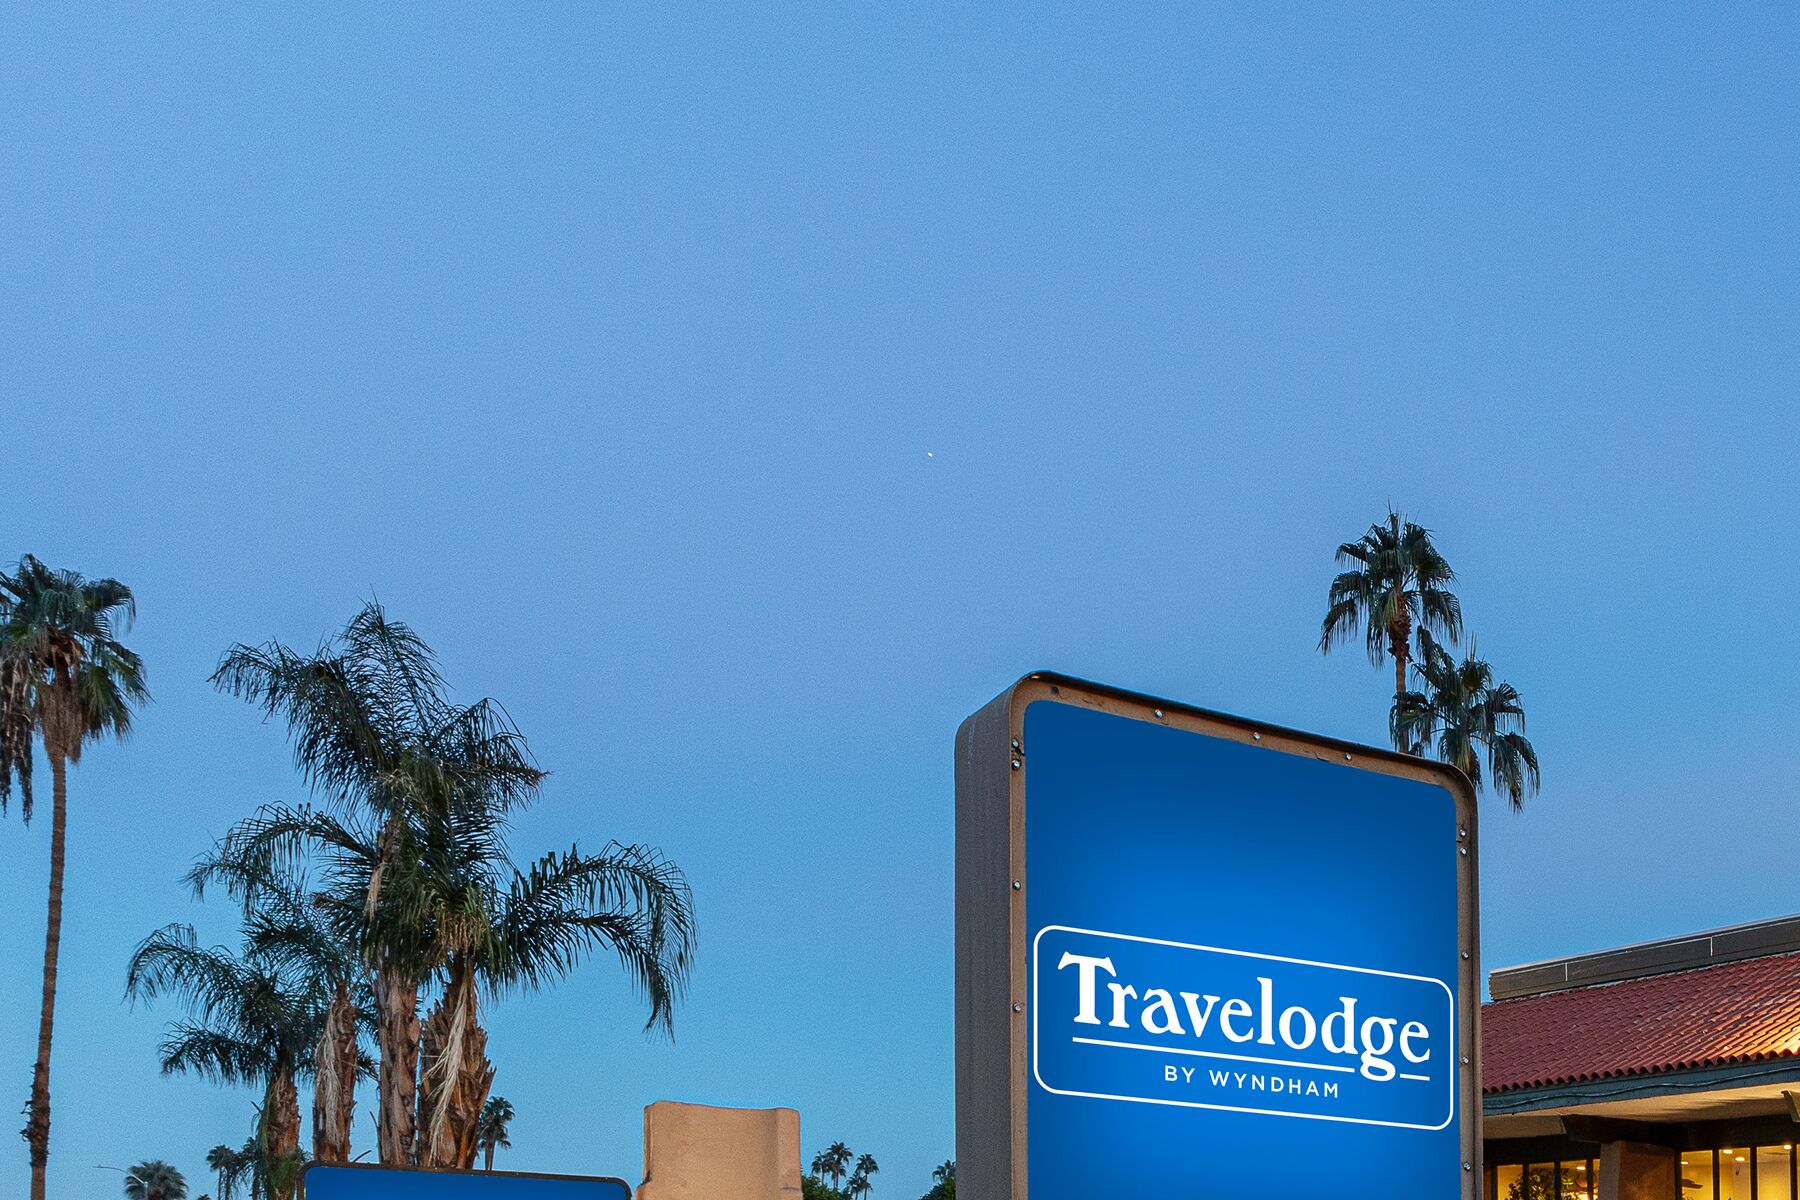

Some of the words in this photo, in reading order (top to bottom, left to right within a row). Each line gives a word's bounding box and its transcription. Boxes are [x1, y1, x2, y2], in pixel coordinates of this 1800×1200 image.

[1058, 951, 1431, 1082] Travelodge
[1165, 1065, 1195, 1083] BY
[1209, 1069, 1338, 1099] WYNDHAM
